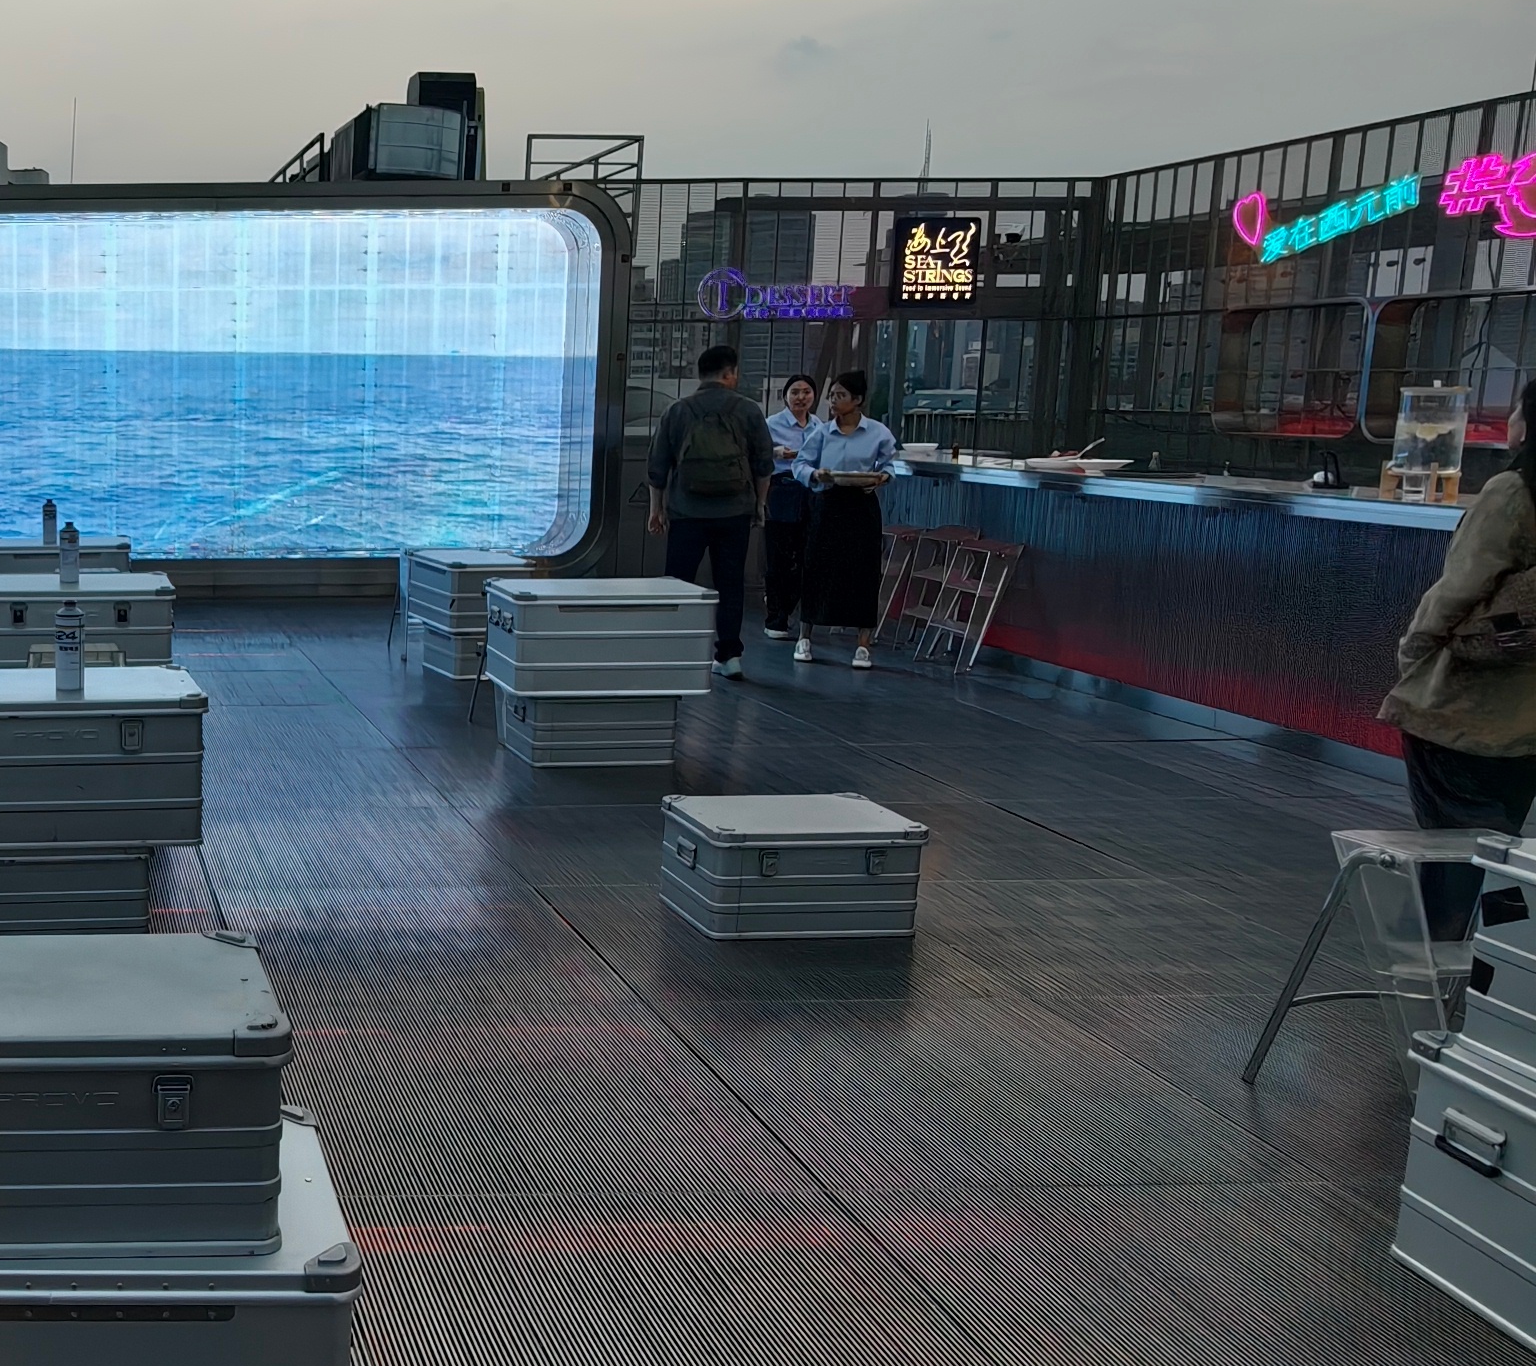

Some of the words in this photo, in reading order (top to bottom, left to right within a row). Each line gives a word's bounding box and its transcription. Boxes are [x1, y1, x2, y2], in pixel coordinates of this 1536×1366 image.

[1260, 172, 1422, 264] 爱在西元前
[904, 255, 938, 269] SEA
[903, 264, 973, 284] STRINGS
[745, 285, 855, 306] DESSERT
